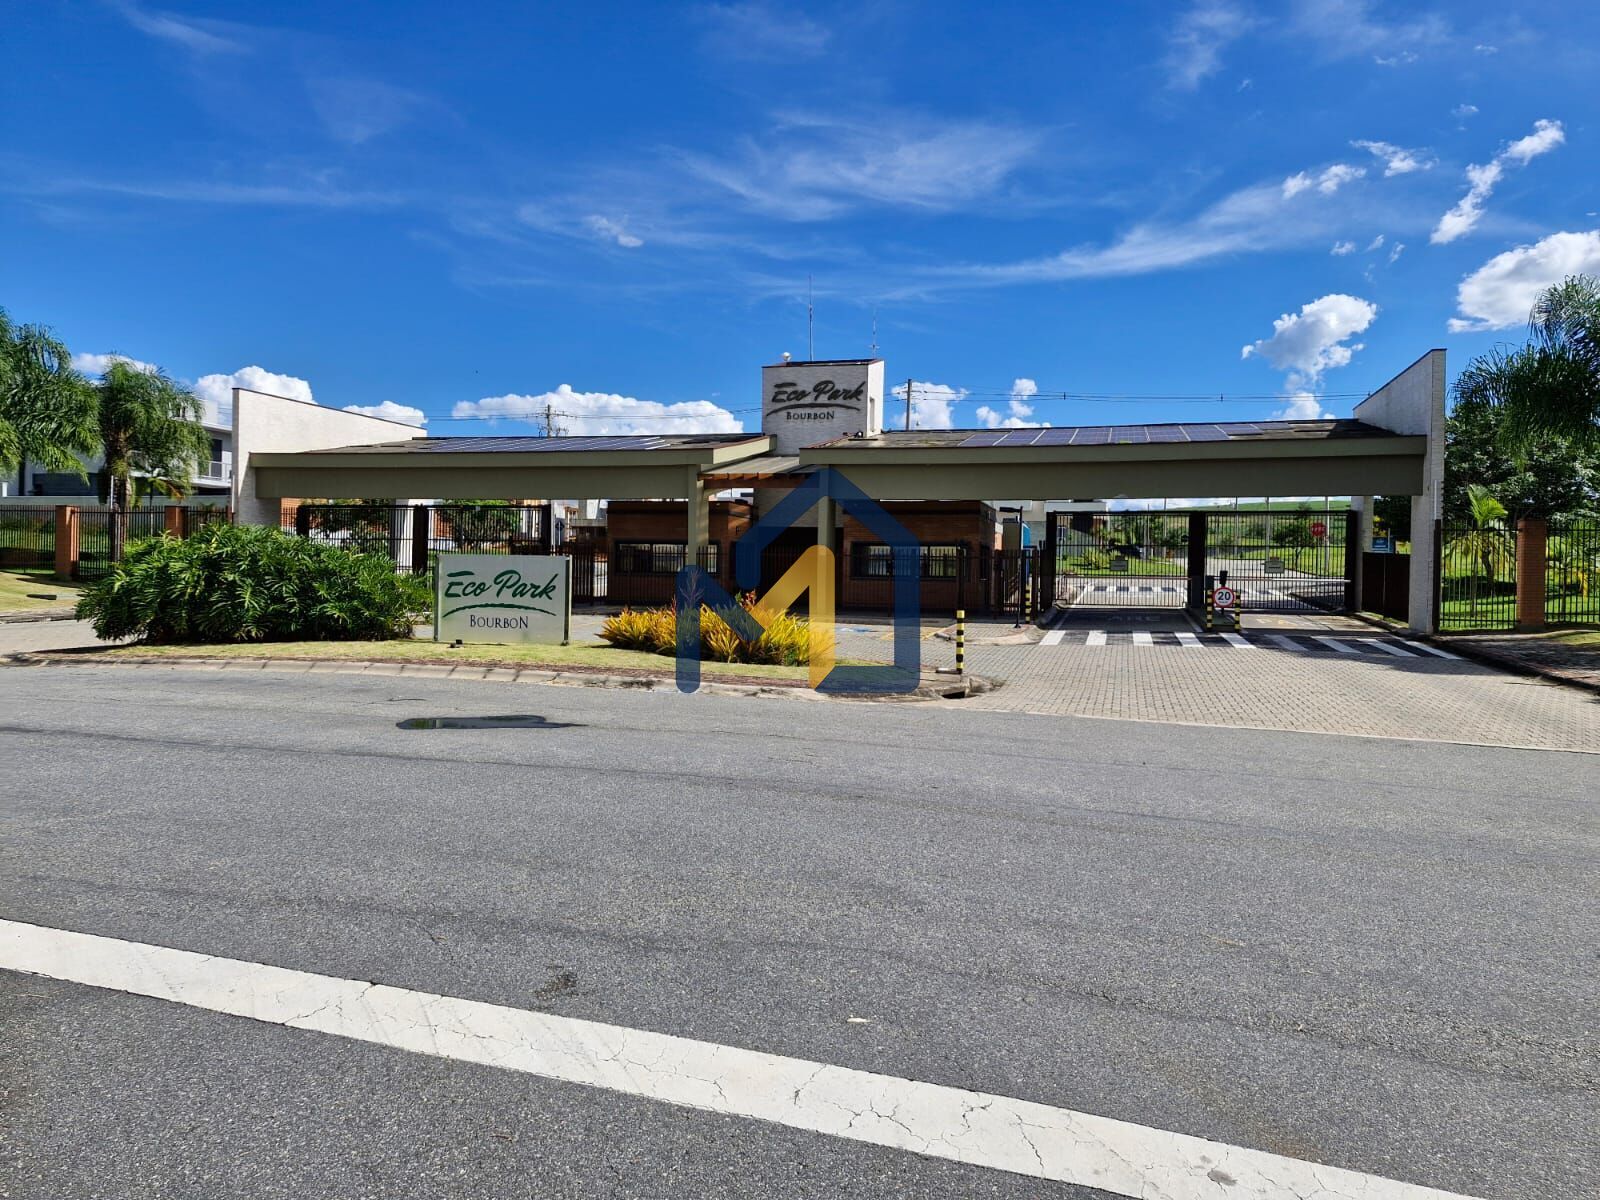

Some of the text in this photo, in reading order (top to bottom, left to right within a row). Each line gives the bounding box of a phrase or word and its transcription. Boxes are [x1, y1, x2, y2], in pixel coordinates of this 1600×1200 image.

[771, 380, 866, 402] Eco Park
[786, 410, 835, 420] BOURBON
[444, 569, 559, 600] Eco Park
[1217, 591, 1231, 601] 20
[470, 614, 529, 629] BOURBON
